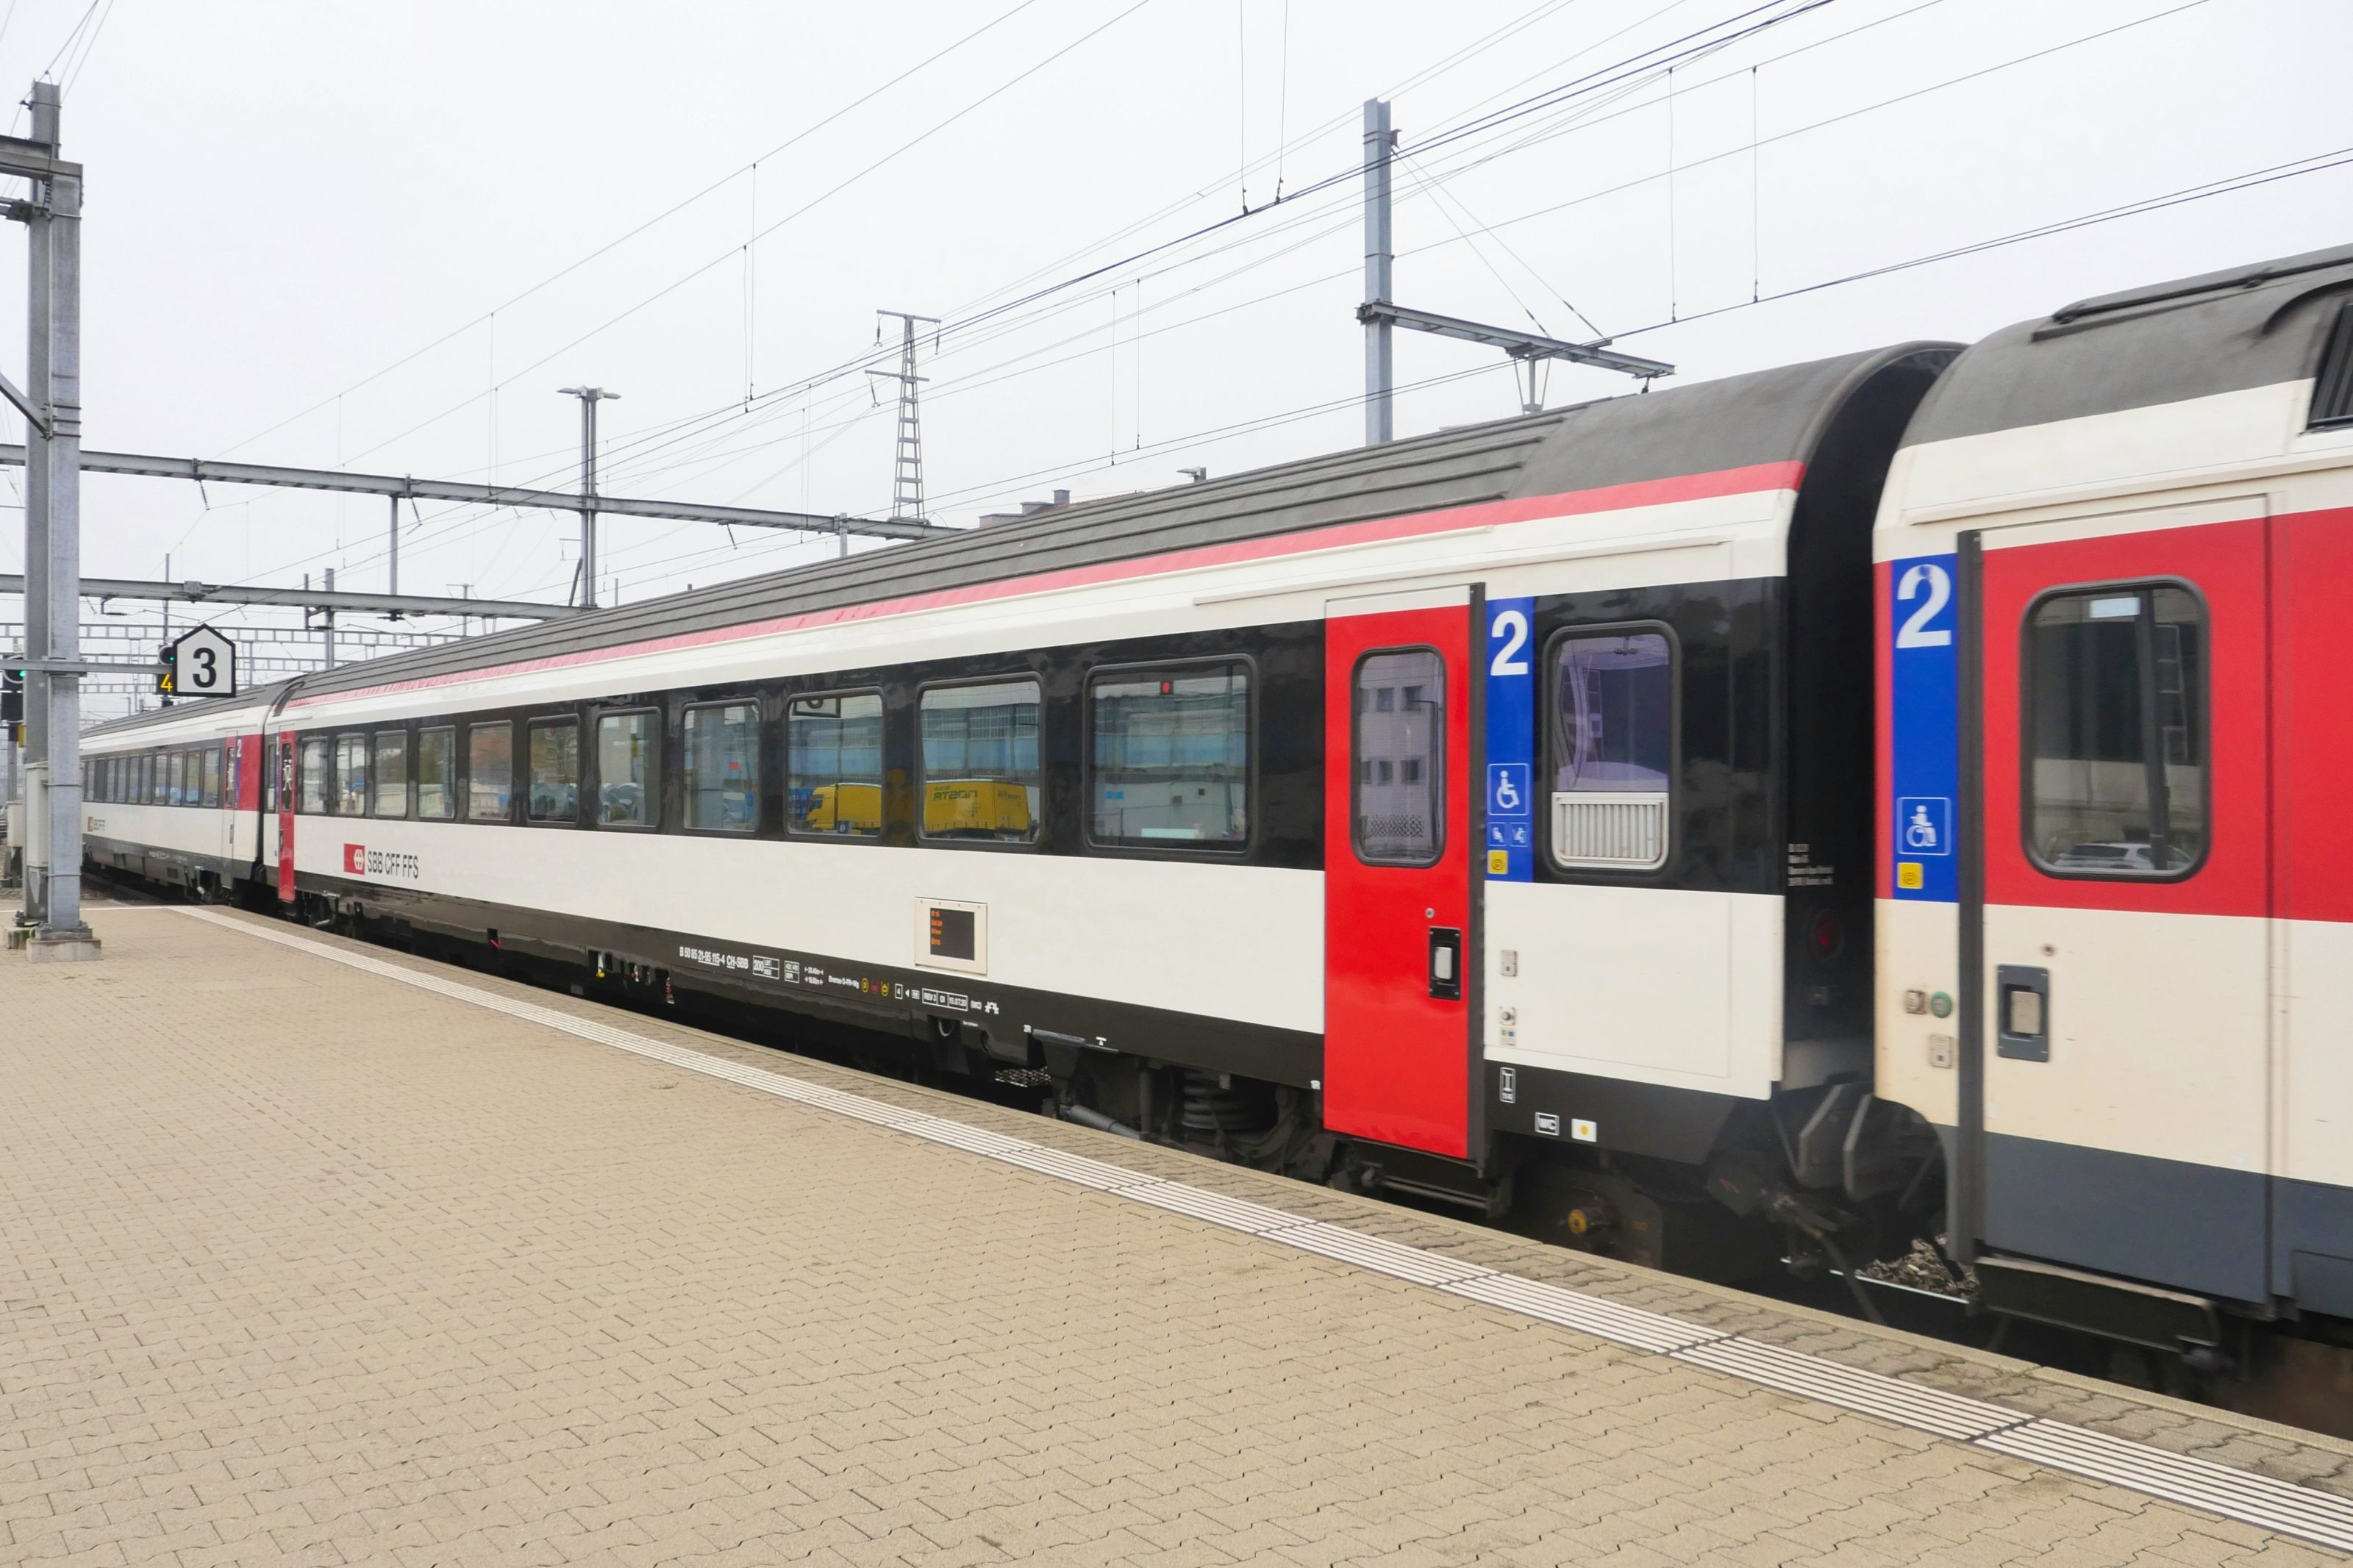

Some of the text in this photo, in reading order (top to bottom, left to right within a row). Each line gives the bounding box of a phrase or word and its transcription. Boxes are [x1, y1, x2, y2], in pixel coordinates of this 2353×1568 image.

[1896, 563, 1952, 648] 2
[1490, 610, 1528, 676] 2
[193, 647, 217, 688] 3
[160, 673, 174, 692] 4
[237, 739, 242, 757] 2
[368, 851, 418, 878] SBB CFF FFS
[679, 946, 684, 957] B
[753, 959, 764, 972] 200
[1538, 1117, 1557, 1131] WC
